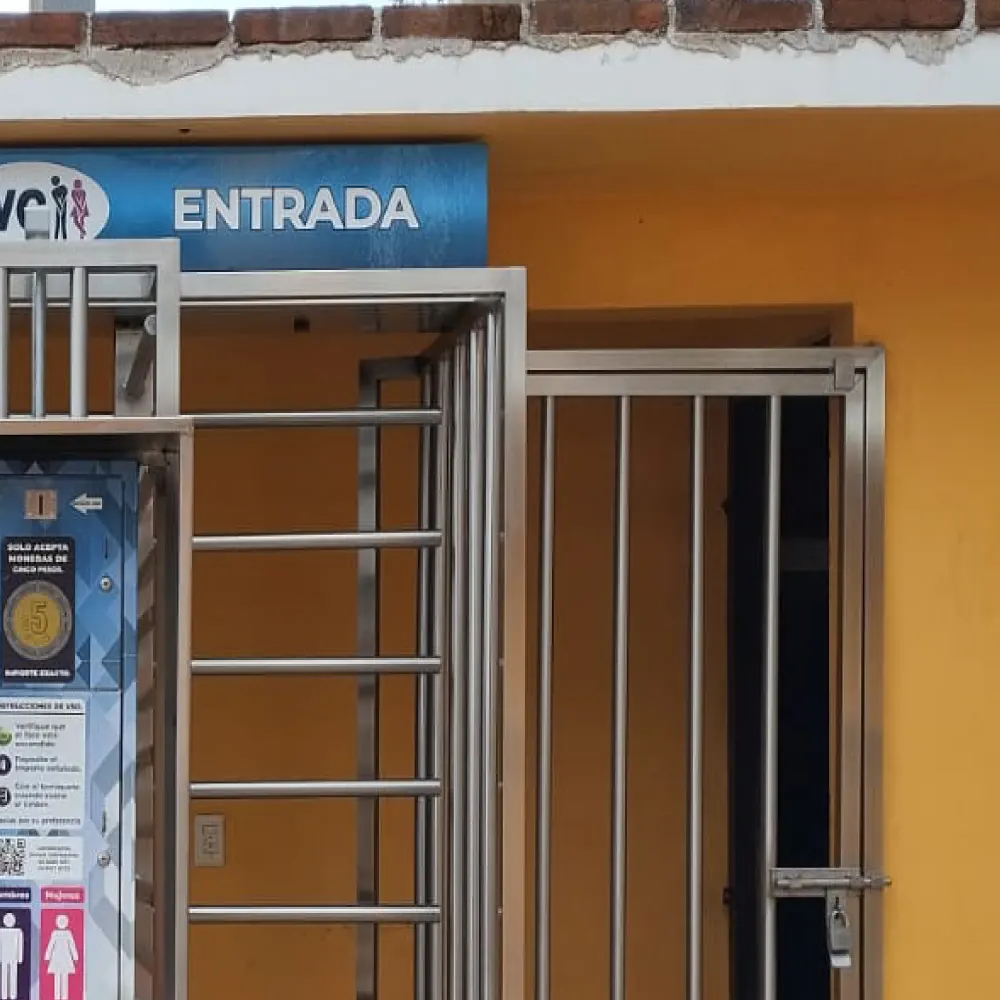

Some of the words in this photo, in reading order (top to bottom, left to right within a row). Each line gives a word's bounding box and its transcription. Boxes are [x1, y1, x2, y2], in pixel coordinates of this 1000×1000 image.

[173, 186, 419, 231] ENTRADA
[6, 543, 32, 552] SOLO
[33, 543, 69, 552] ACEPTA
[8, 554, 54, 563] MONEDAS
[55, 554, 68, 563] DE
[29, 599, 49, 636] 5
